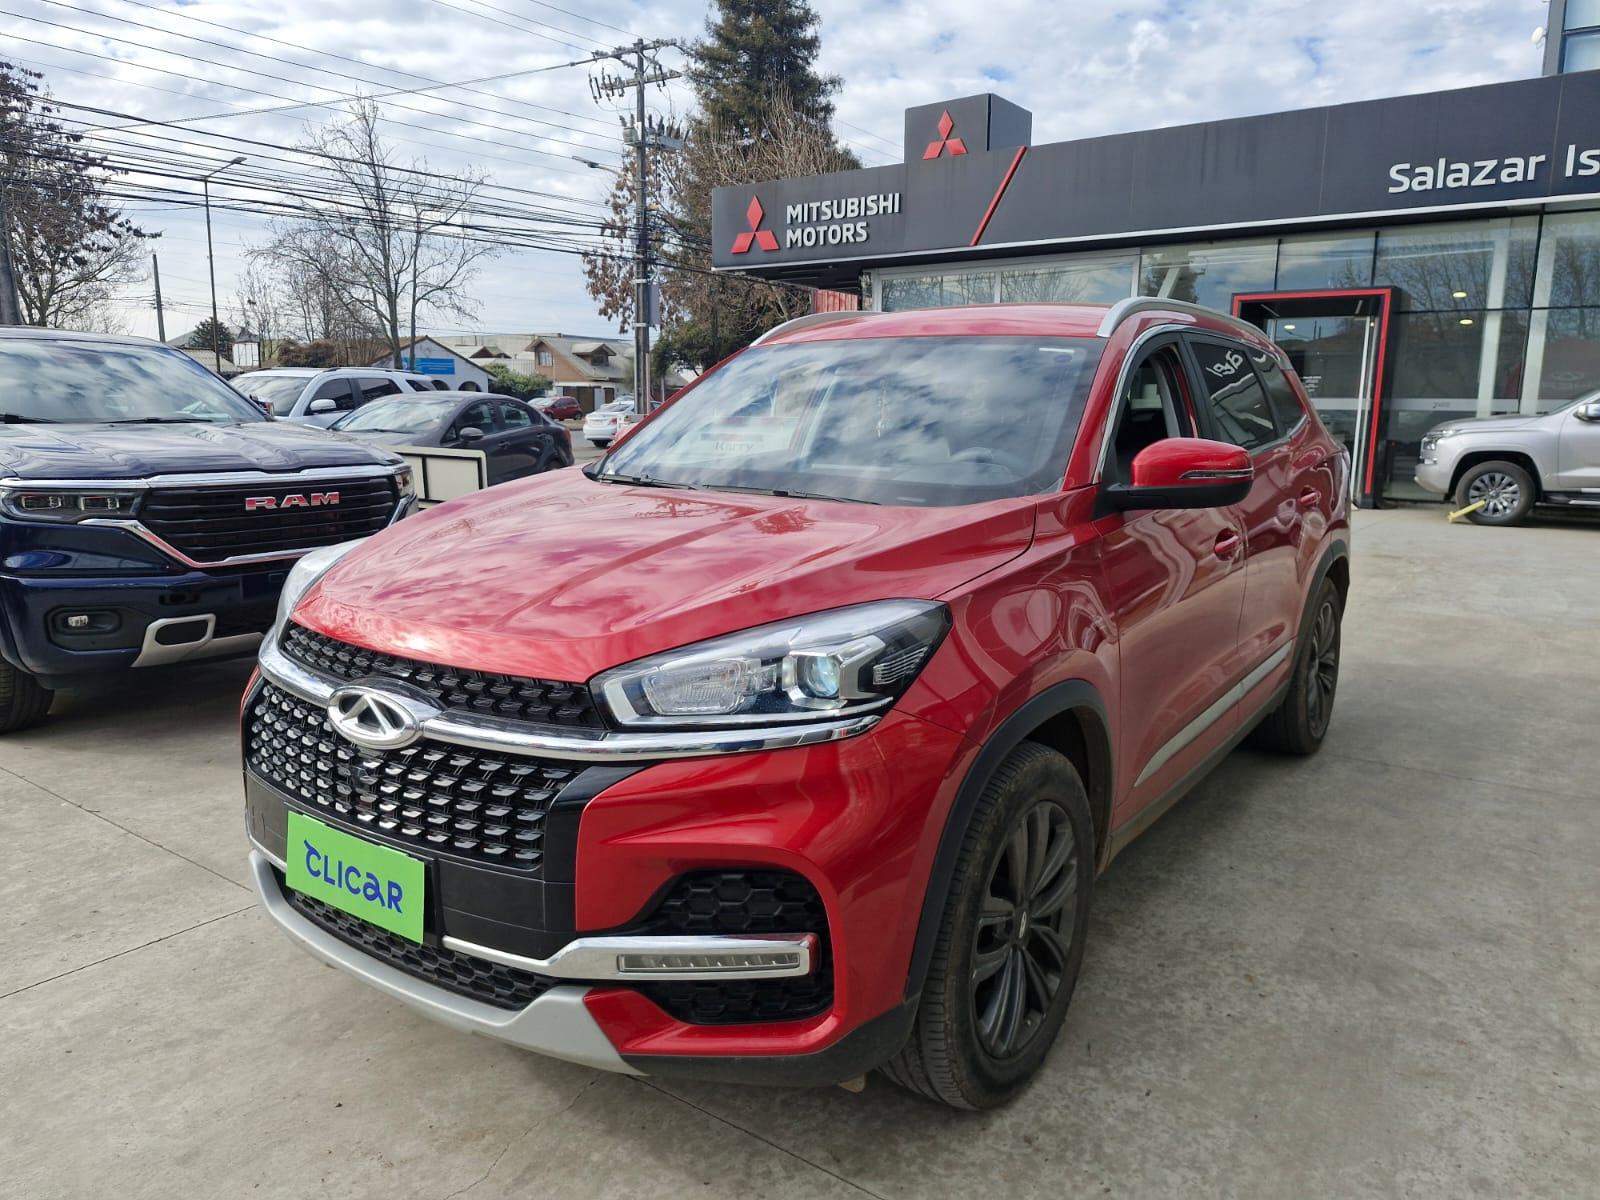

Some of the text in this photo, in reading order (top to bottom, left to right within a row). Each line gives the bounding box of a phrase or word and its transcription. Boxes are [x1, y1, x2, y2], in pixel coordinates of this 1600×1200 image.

[1388, 154, 1546, 194] Salazar
[786, 192, 900, 225] MITSUBISHI
[786, 221, 868, 249] MOTORS
[245, 491, 340, 511] RAM
